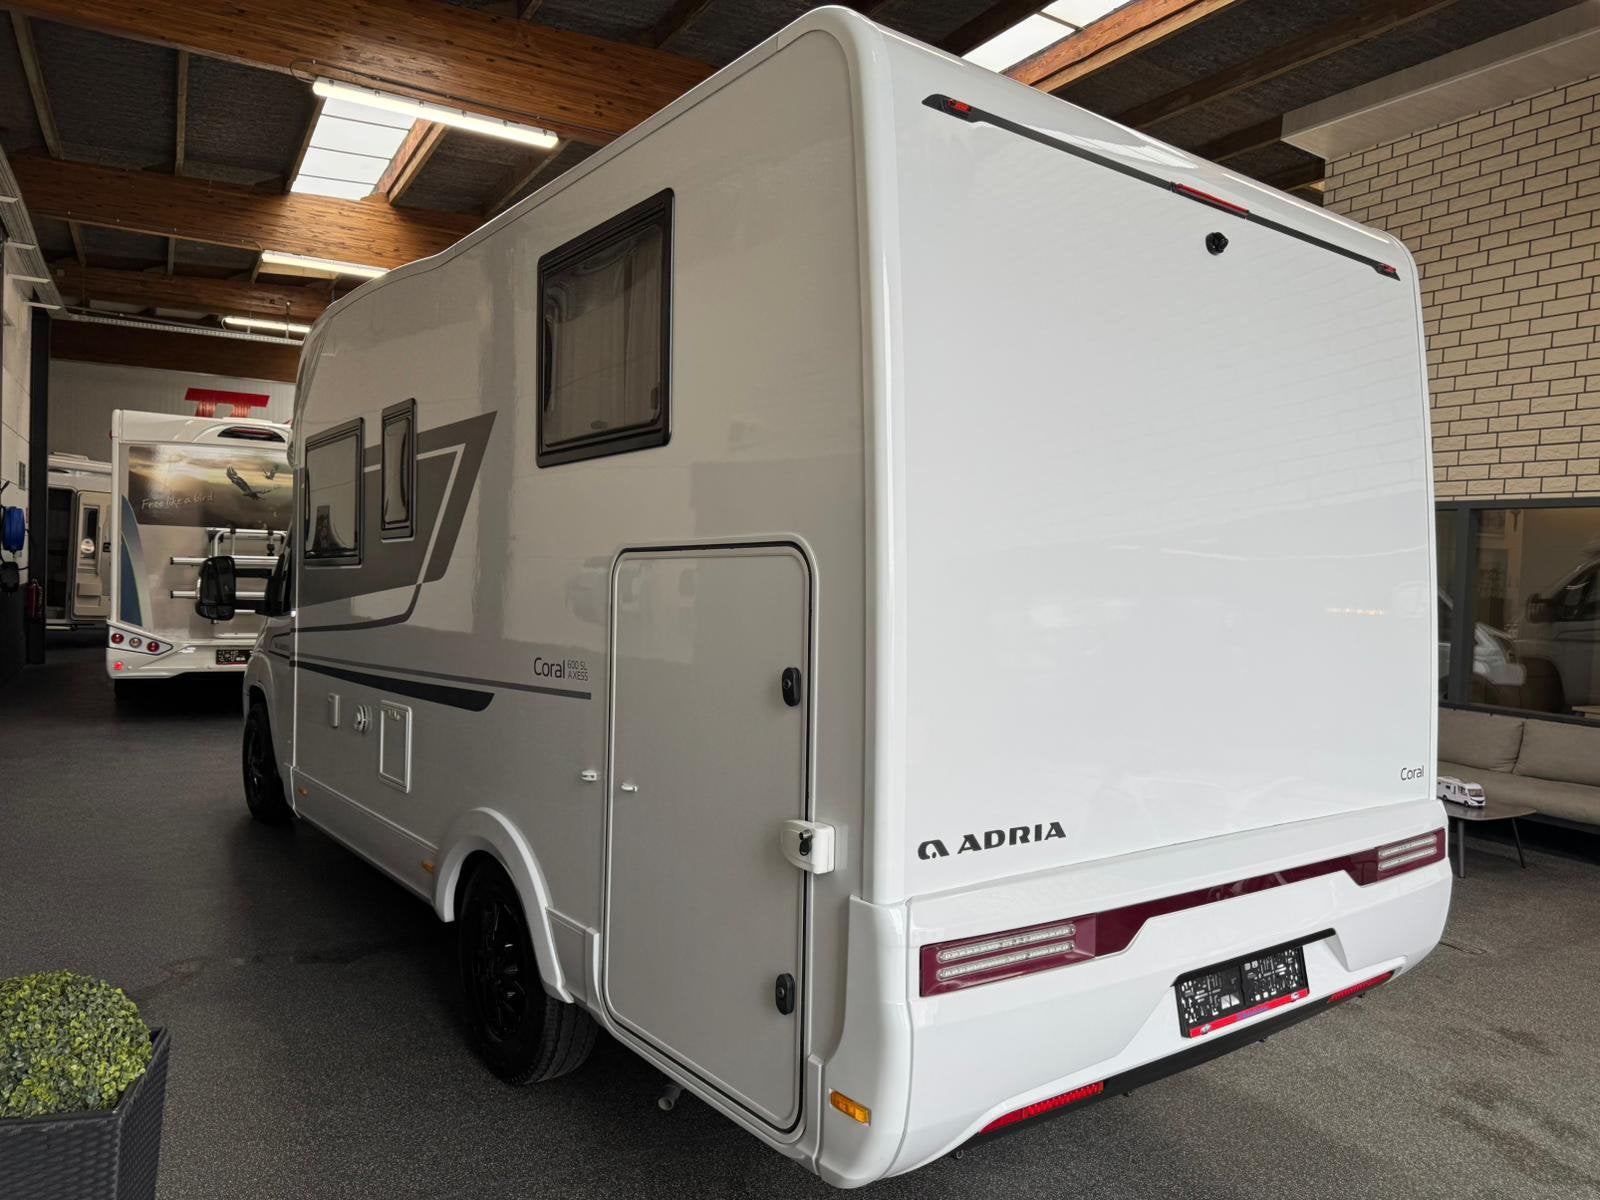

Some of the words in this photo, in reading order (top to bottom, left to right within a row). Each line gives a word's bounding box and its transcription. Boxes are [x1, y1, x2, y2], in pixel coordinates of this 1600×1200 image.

[141, 497, 164, 510] Free
[533, 657, 565, 679] Coral
[567, 670, 589, 681] AXESS
[1400, 765, 1424, 781] Coral
[957, 821, 1067, 854] ADRIA
